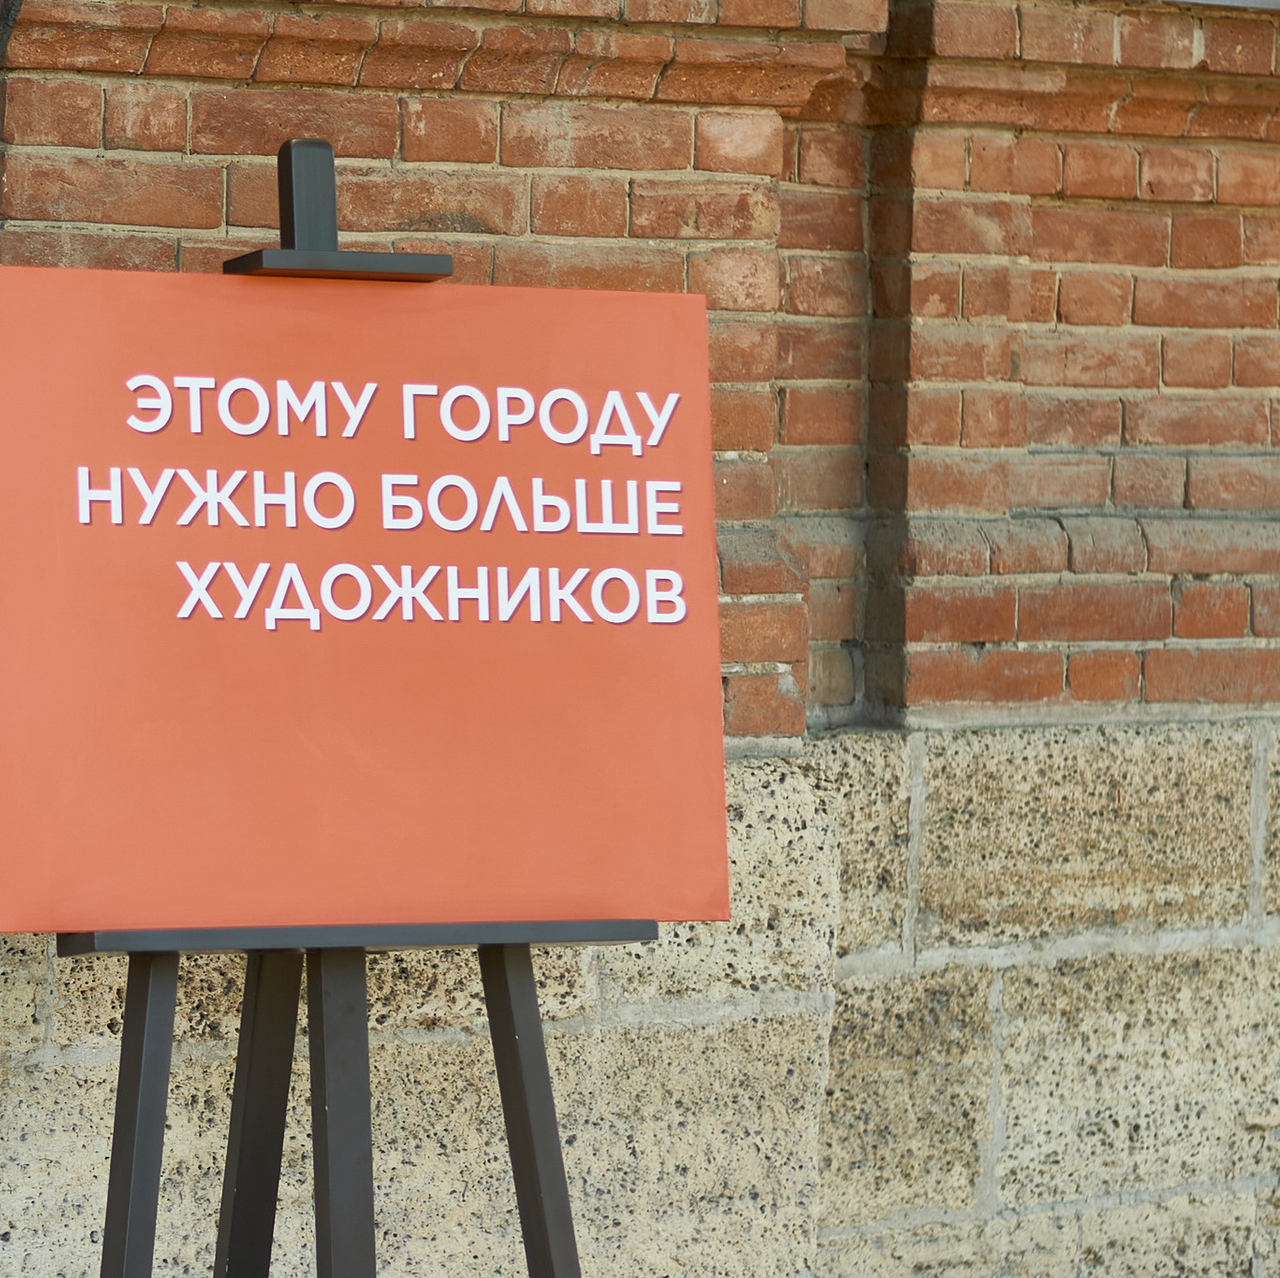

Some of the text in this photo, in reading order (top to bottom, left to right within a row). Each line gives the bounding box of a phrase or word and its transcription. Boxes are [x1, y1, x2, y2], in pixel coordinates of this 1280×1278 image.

[125, 374, 681, 456] ЭТОМУ ГОРОДУ
[77, 466, 684, 535] НУЖНО БОЛЬШЕ
[175, 560, 688, 631] ХУДОЖНИКОВ
